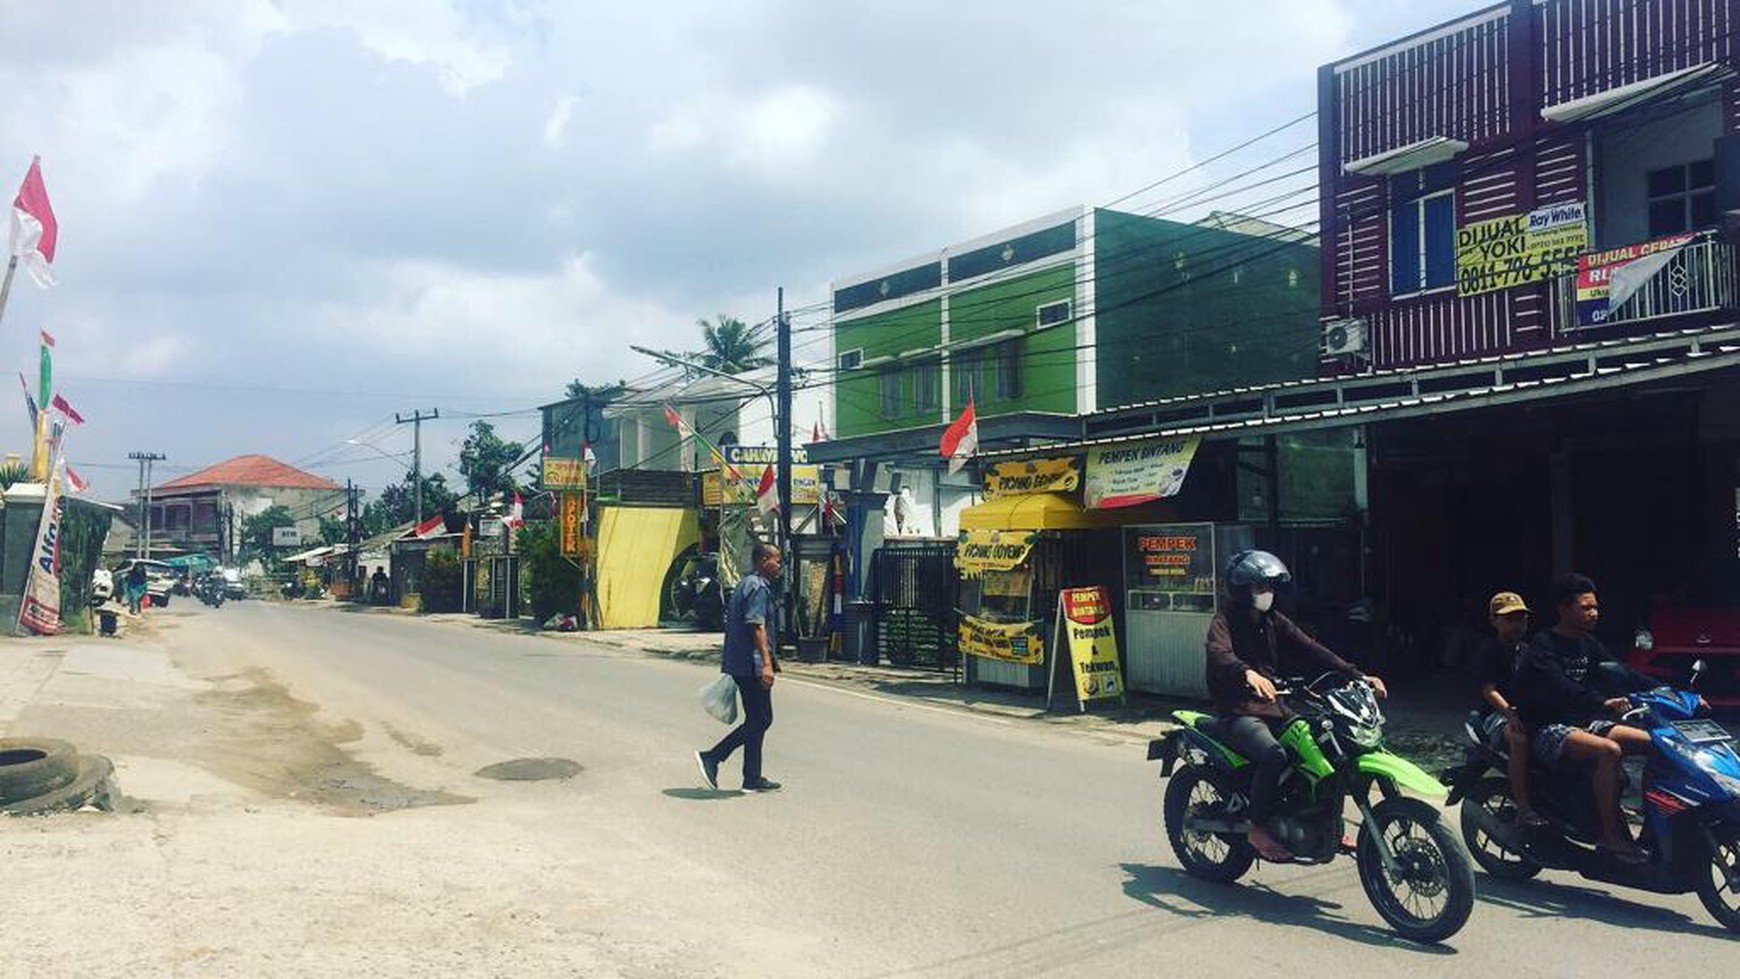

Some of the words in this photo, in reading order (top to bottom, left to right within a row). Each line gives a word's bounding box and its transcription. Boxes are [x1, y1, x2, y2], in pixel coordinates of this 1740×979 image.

[1529, 212, 1550, 228] Ray
[1459, 217, 1525, 247] DIJUAL
[1480, 236, 1526, 260] YOKI
[1587, 247, 1637, 266] DIJUAL
[1098, 447, 1139, 464] PEMPEK
[1140, 439, 1187, 460] BINTANG
[1138, 536, 1198, 552] PEMPEK
[1071, 589, 1101, 603] PEMPEK
[1073, 625, 1111, 640] Pempek
[1091, 644, 1099, 655] &
